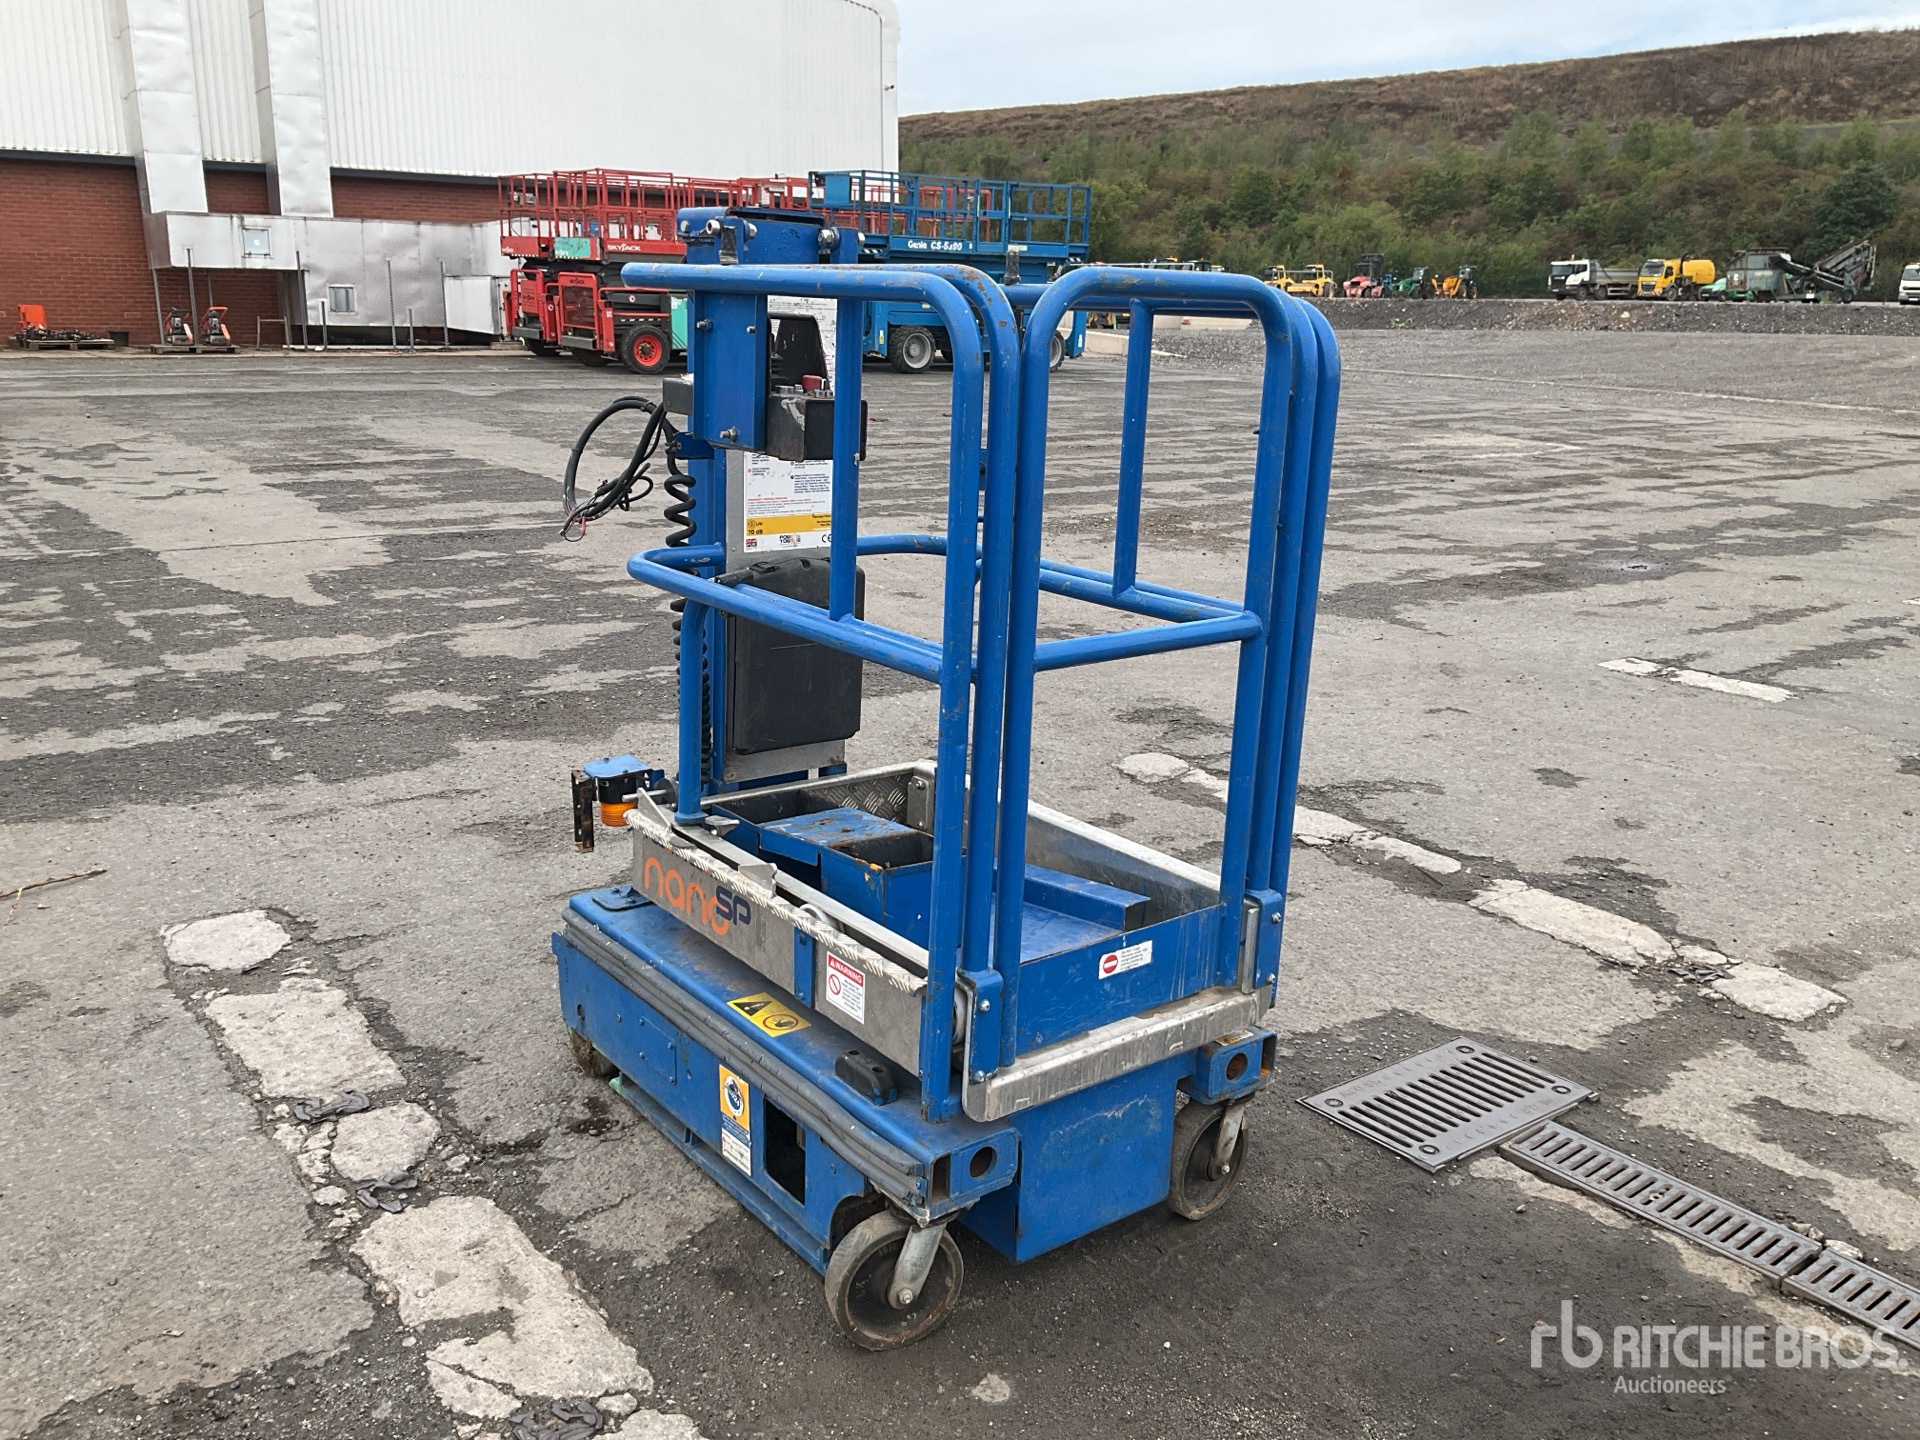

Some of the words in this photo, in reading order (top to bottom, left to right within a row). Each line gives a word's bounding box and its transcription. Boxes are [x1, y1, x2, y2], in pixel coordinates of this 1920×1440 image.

[607, 243, 641, 252] SKYJACK
[908, 240, 927, 249] Genie
[644, 856, 731, 936] nano
[716, 885, 751, 926] SP
[834, 961, 863, 984] WARNING
